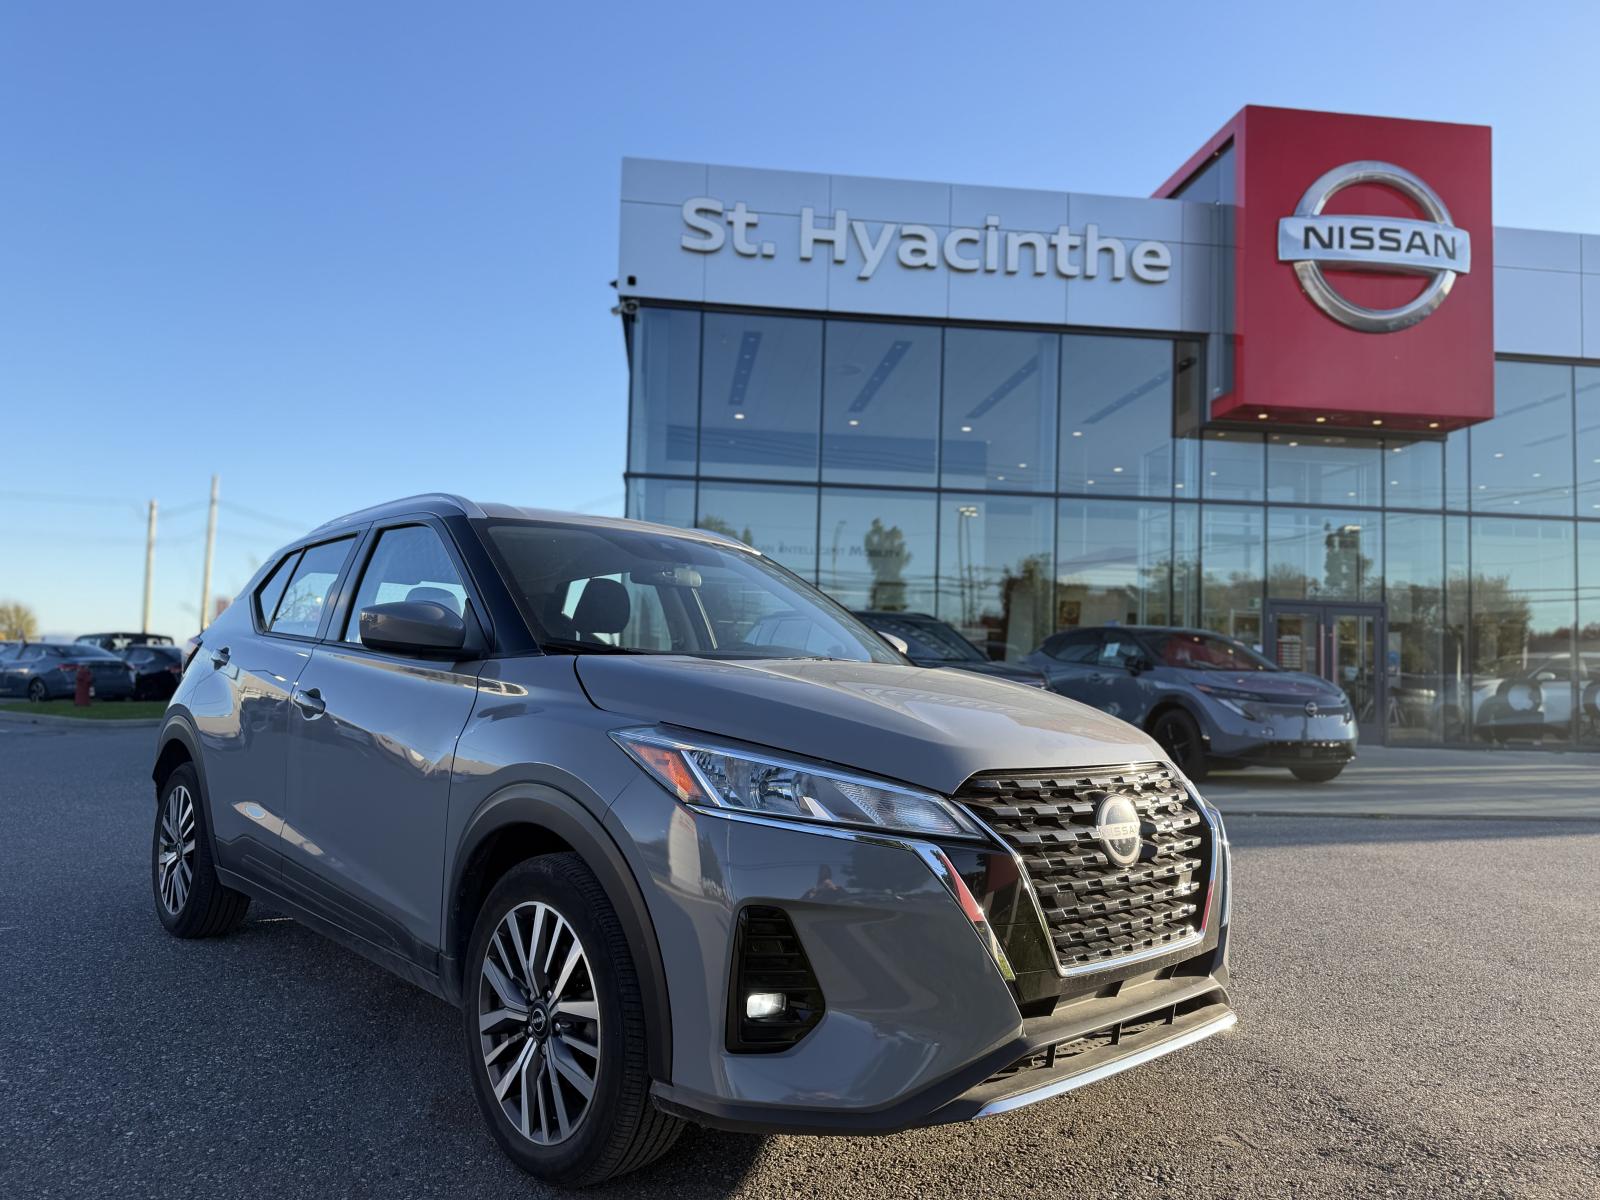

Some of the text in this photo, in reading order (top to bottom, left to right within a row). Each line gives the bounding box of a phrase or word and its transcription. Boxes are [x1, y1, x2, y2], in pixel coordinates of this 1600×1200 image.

[681, 197, 1172, 283] St. Hyacinthe
[1303, 226, 1456, 261] NISSAN
[1103, 824, 1136, 837] ISSA
